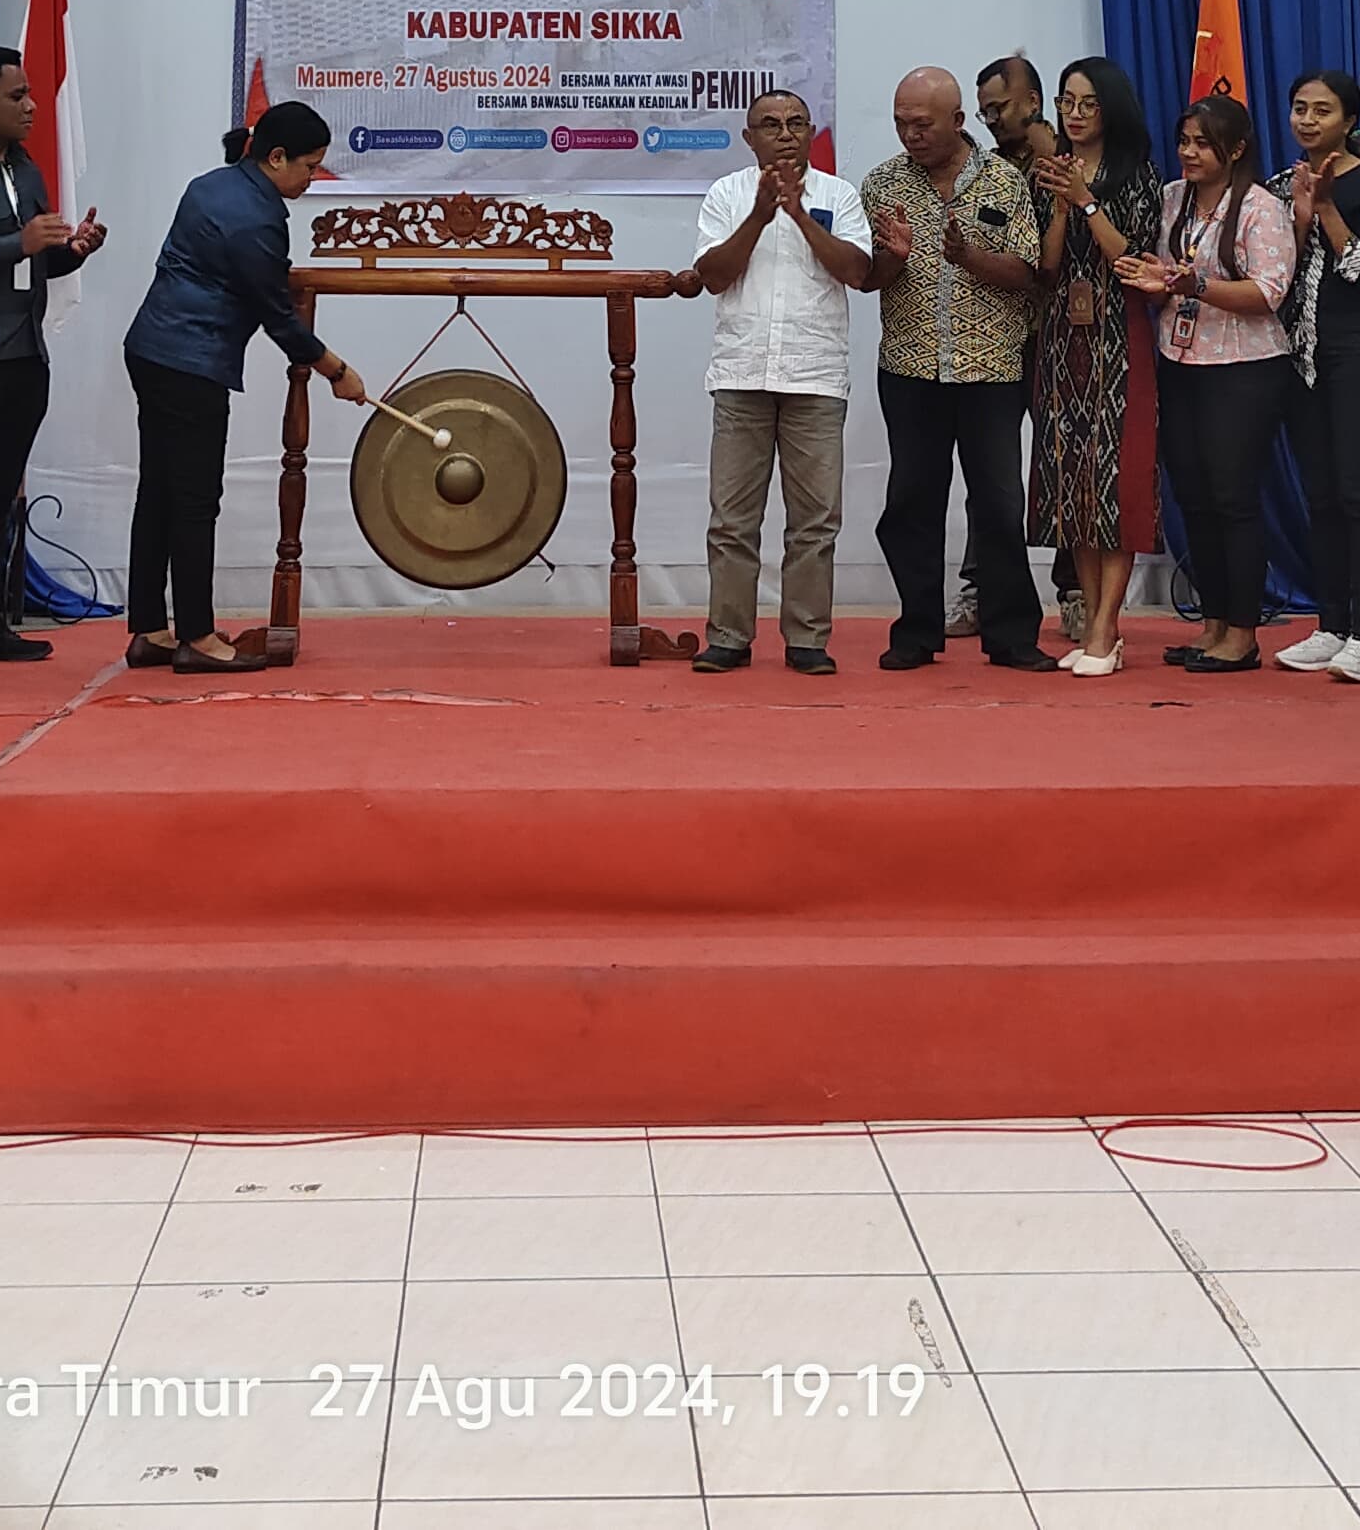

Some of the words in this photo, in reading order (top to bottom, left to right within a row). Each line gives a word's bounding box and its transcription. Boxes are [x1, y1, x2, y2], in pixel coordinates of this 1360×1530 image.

[407, 11, 581, 39] KABUPATEN
[591, 12, 682, 40] SIKKA
[297, 66, 389, 91] Maumere,
[395, 66, 418, 87] 27
[424, 66, 498, 92] Agustus
[503, 66, 551, 87] 2024
[561, 74, 611, 87] BERSAMA
[614, 74, 652, 87] RAKYAT
[655, 74, 688, 87] AWASI
[477, 96, 528, 109] BERSAMA
[531, 96, 579, 109] BAWASLU
[583, 96, 635, 109] TEGAKKAN
[639, 96, 689, 109] KEADILAN
